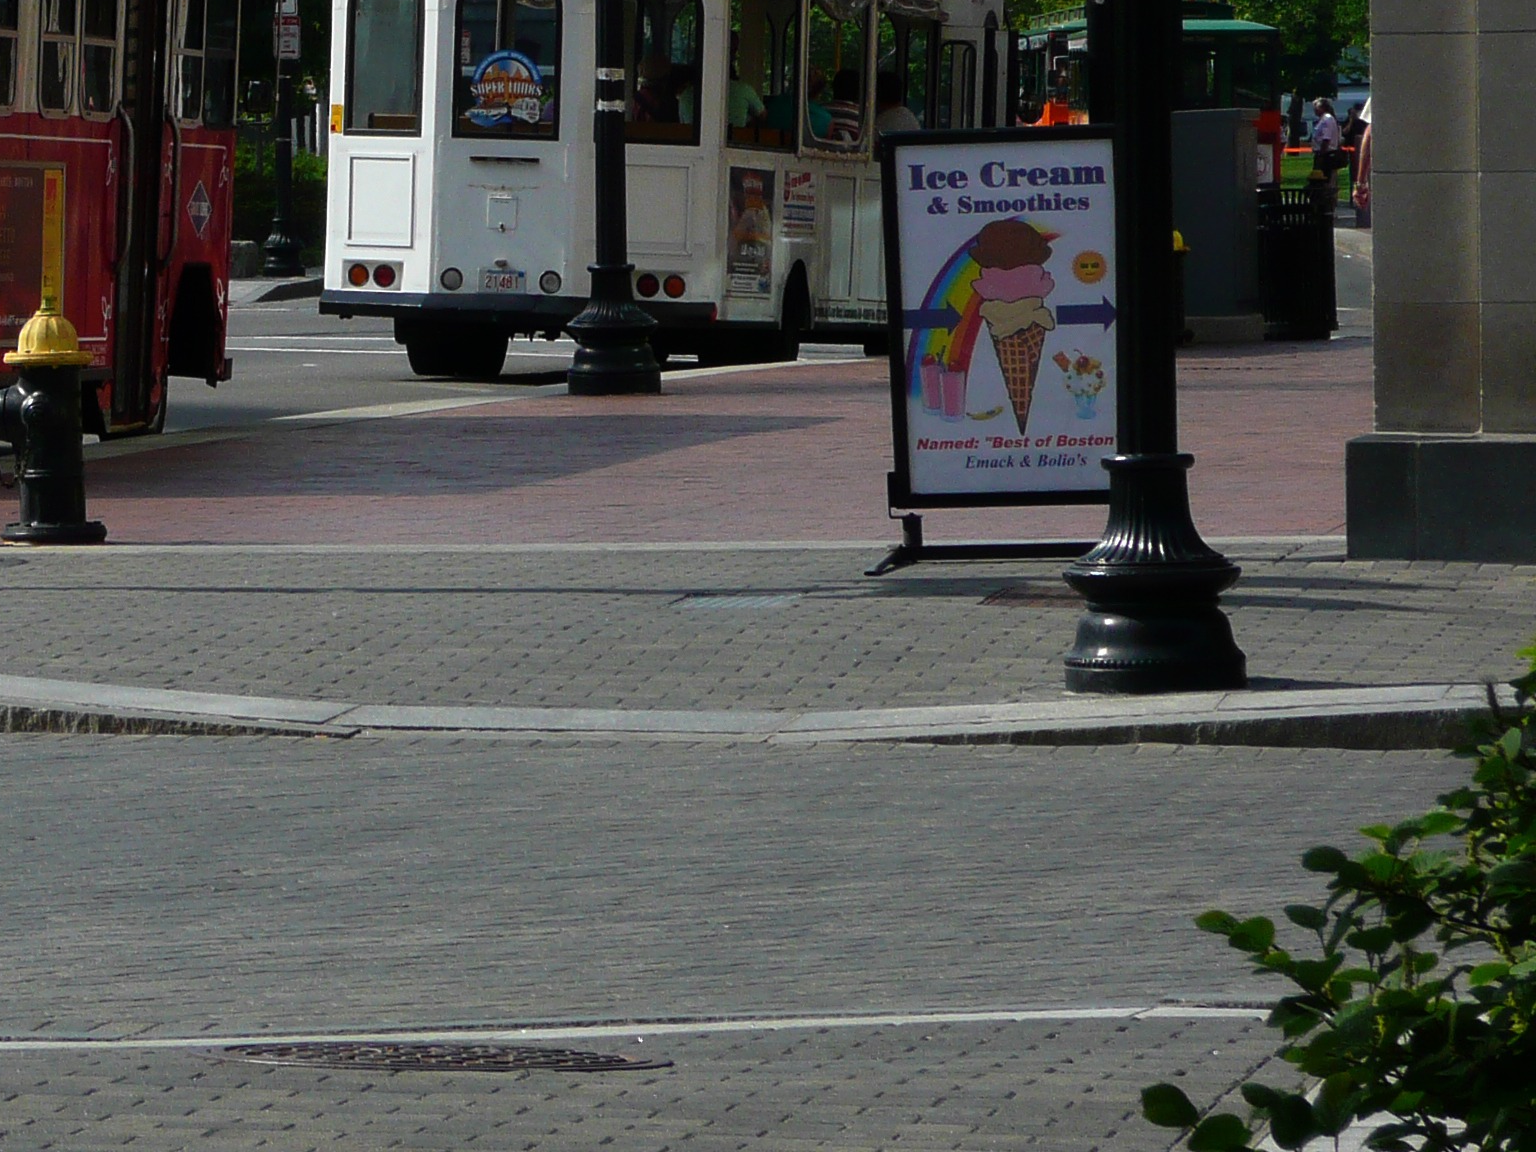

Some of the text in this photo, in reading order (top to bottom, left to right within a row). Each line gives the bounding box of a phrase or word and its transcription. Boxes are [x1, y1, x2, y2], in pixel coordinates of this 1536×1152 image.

[469, 80, 505, 98] SUPER
[907, 161, 1107, 191] Ice Cream
[926, 192, 1090, 215] & Smoothies
[916, 434, 1115, 451] Named: "Best of Boston
[965, 453, 1088, 470] Emack & Bolio's
